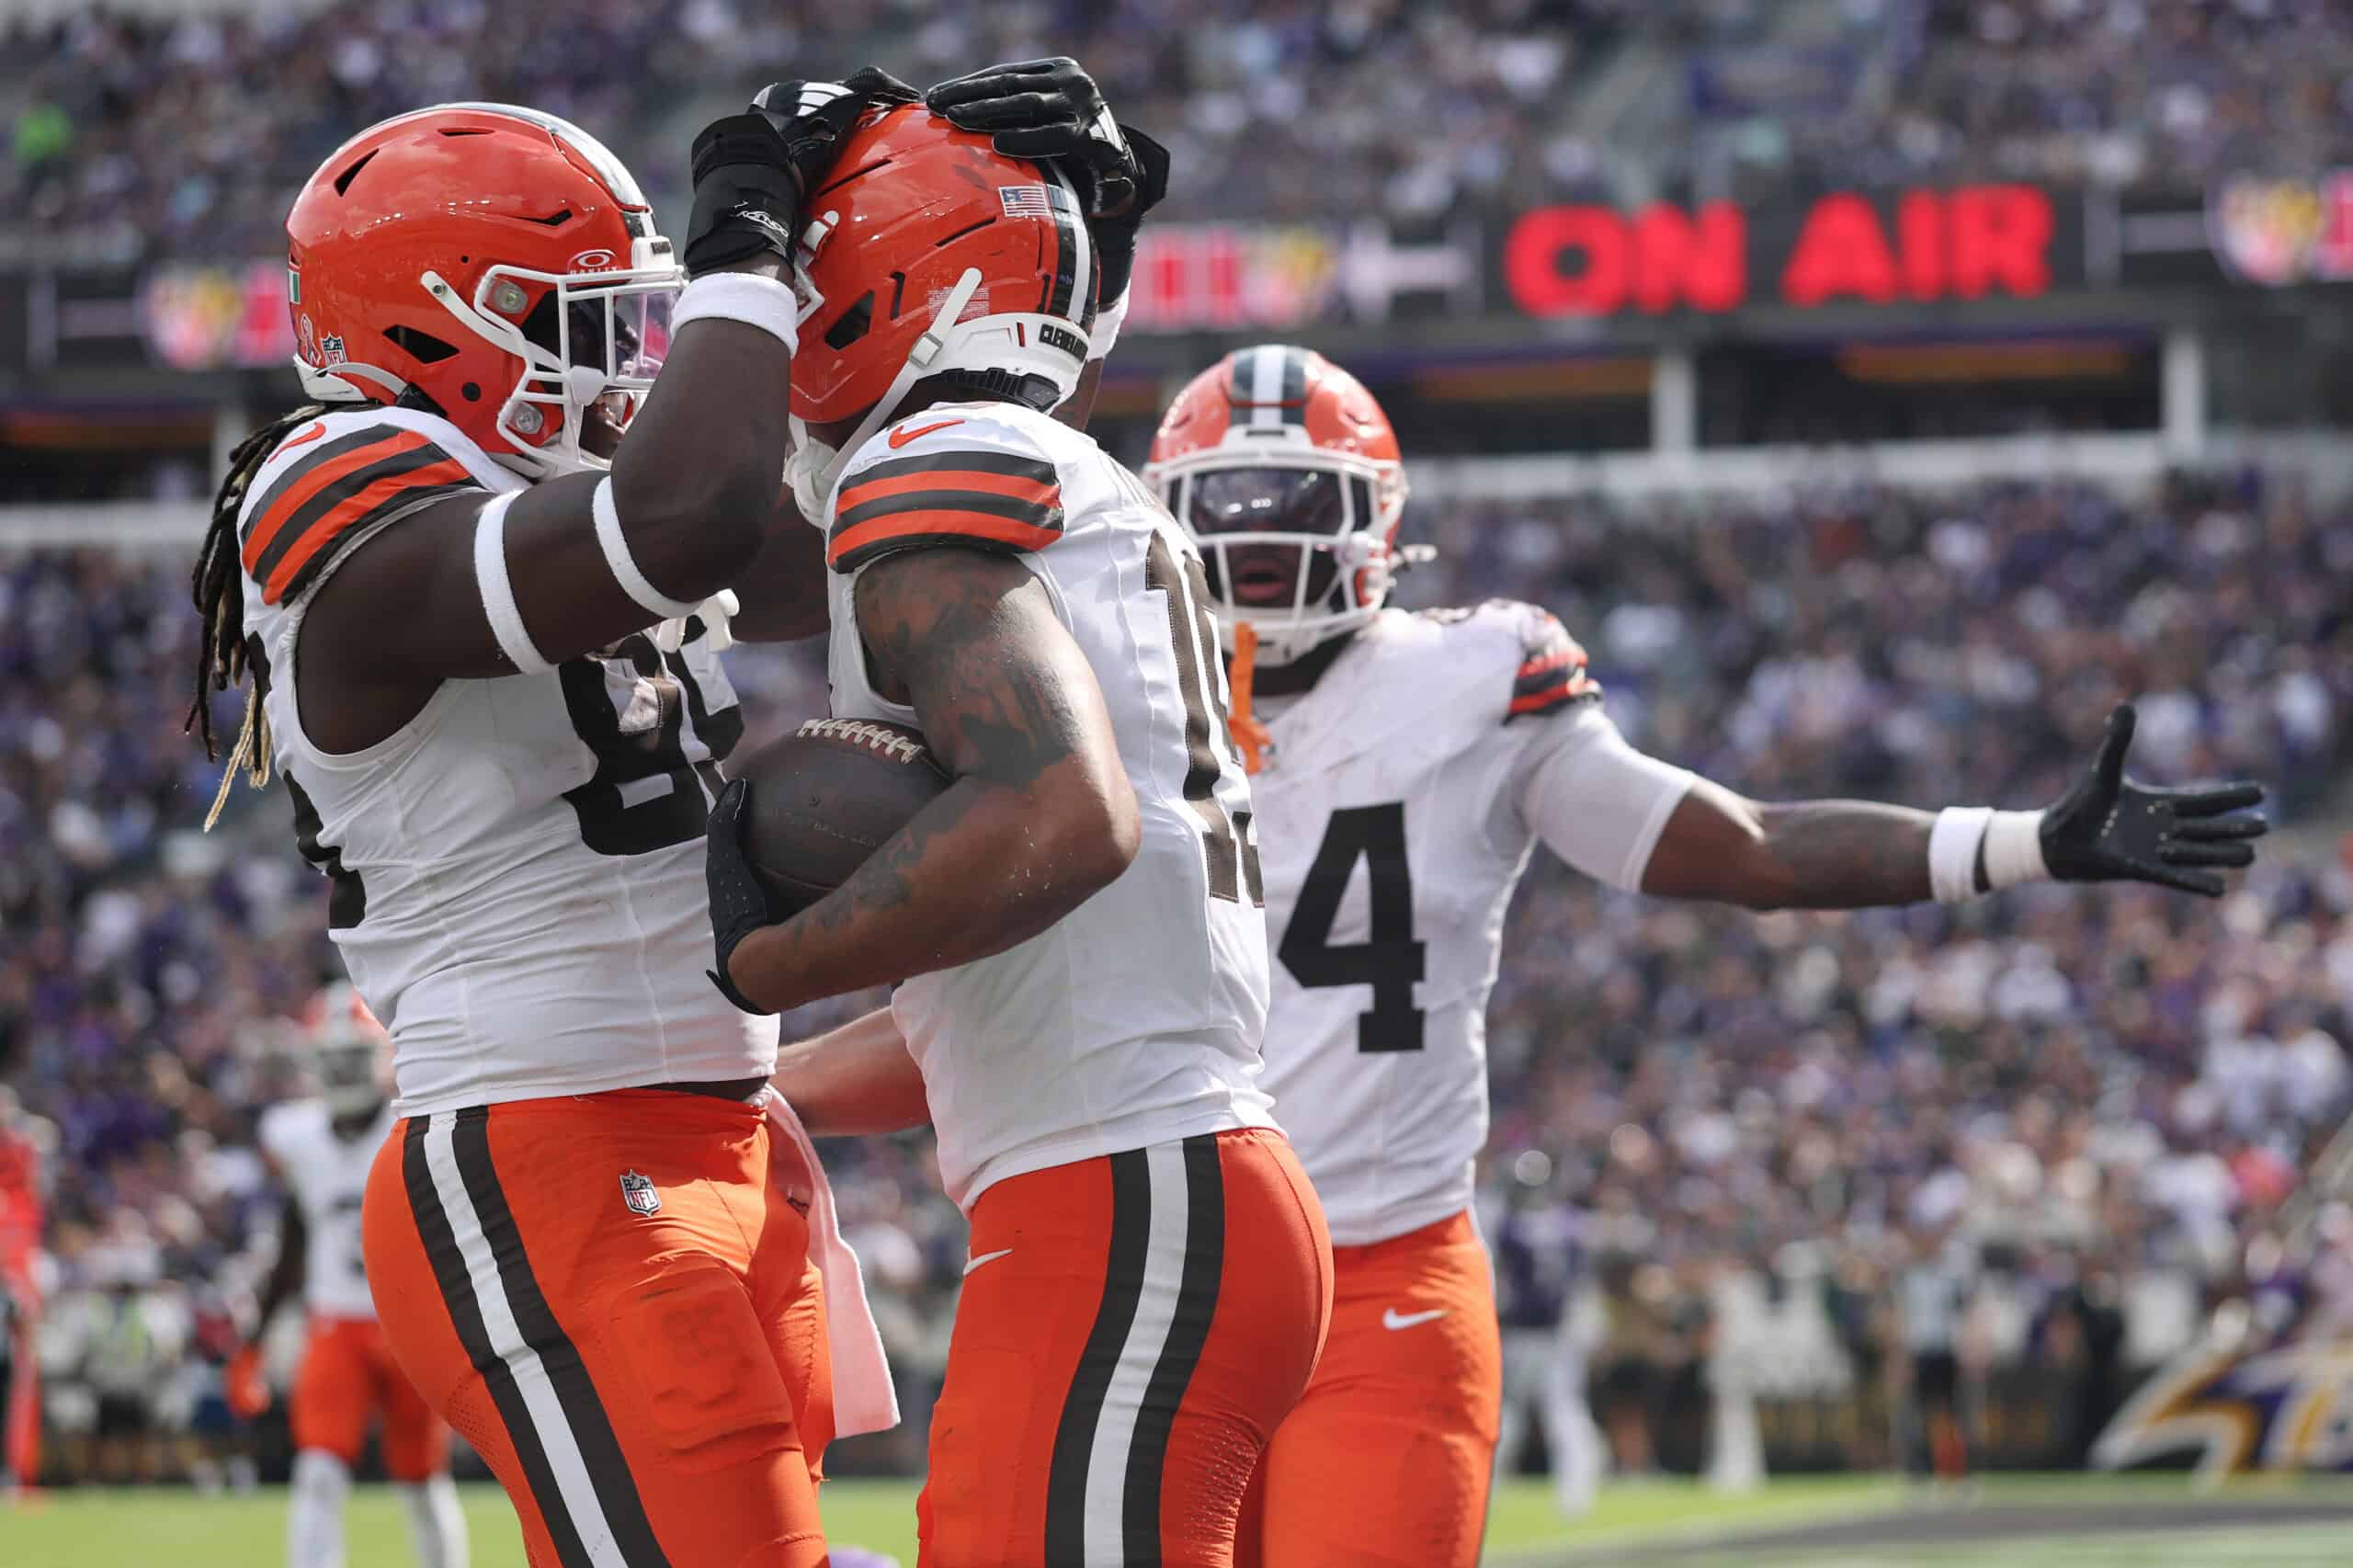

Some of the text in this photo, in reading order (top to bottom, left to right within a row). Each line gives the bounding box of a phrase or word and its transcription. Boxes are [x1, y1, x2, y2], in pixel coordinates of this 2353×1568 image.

[1505, 185, 2053, 317] ON AIR
[325, 350, 346, 367] NFL
[1278, 801, 1426, 1052] 4
[629, 1190, 656, 1209] NFL
